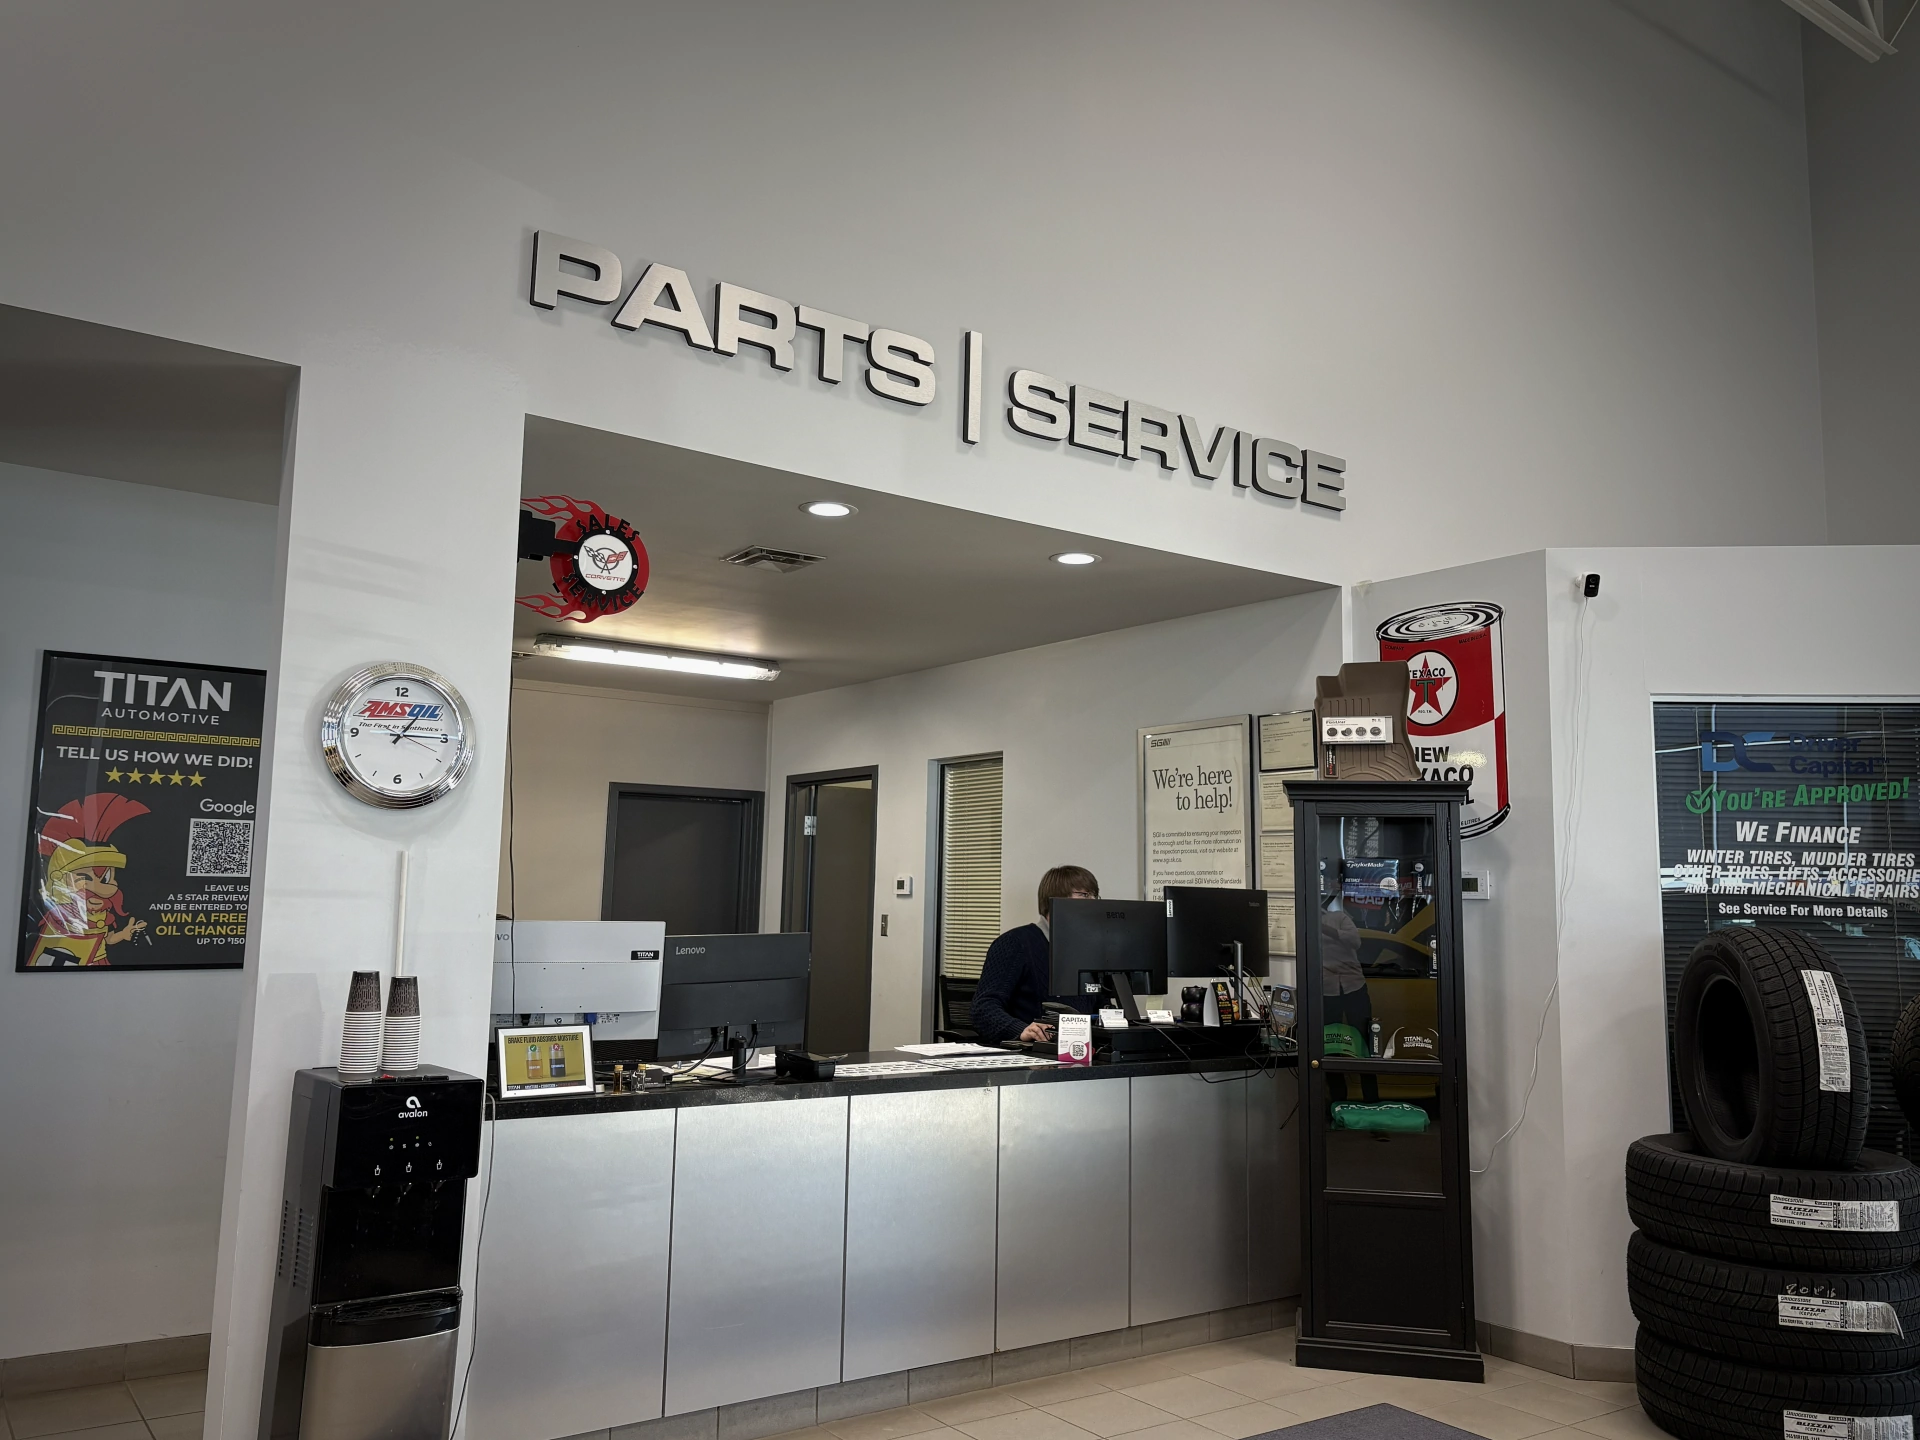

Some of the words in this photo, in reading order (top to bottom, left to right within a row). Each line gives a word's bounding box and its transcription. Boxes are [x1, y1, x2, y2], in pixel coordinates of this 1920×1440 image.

[530, 230, 936, 406] PARTS
[1007, 369, 1346, 511] SERVICE
[576, 514, 640, 542] SALES
[586, 574, 625, 582] CORVETTE
[562, 573, 644, 611] SERVICE
[94, 671, 231, 711] TITAN
[395, 687, 408, 697] 12
[1416, 680, 1435, 702] T
[101, 708, 219, 725] AUTOMOTIVE
[359, 701, 440, 718] AMSOIL
[350, 728, 359, 737] 9
[440, 734, 448, 743] 3
[1789, 732, 1861, 752] Driver
[57, 746, 99, 760] TELL
[105, 749, 129, 761] US
[134, 751, 179, 764] HOW
[184, 754, 213, 766] WE
[218, 756, 253, 768] DID!
[393, 774, 402, 784] 6
[1152, 767, 1194, 789] We're
[1197, 765, 1232, 786] here
[1176, 792, 1190, 810] to
[1194, 786, 1232, 813] help!
[1713, 788, 1786, 811] YOU'RE
[1793, 777, 1909, 807] APPROVED!
[200, 799, 254, 816] Google
[1464, 817, 1481, 825] LITRES
[1736, 821, 1768, 842] WE
[1775, 822, 1861, 843] FINANCE
[1687, 850, 1744, 864] WINTER
[1750, 851, 1796, 866] TIRES,
[1801, 852, 1867, 866] MUDDER
[1872, 853, 1915, 867] TIRES
[1673, 864, 1721, 879] OTHER
[1727, 865, 1773, 881] TIRES,
[1778, 866, 1823, 882] LIFTS,
[1827, 867, 1920, 884] ACCESSORIE
[1684, 884, 1708, 894] AND
[1712, 884, 1748, 895] OTHER
[1751, 881, 1850, 897] MECHANICAL
[1853, 883, 1919, 898] REPAIRS
[161, 913, 192, 922] WIN
[196, 913, 206, 922] A
[211, 913, 246, 922] FREE
[1719, 903, 1740, 914] See
[1743, 903, 1786, 915] Service
[1791, 905, 1809, 915] For
[1813, 905, 1843, 917] More
[1846, 906, 1888, 918] Details
[156, 926, 180, 935] OIL
[184, 926, 246, 935] CHANGE
[676, 946, 705, 956] Lenovo
[398, 1109, 428, 1118] avalon
[1783, 1205, 1820, 1213] BLIZZAK
[1791, 1305, 1826, 1313] BLIZZAK
[1796, 1421, 1833, 1429] BLIZZAK
